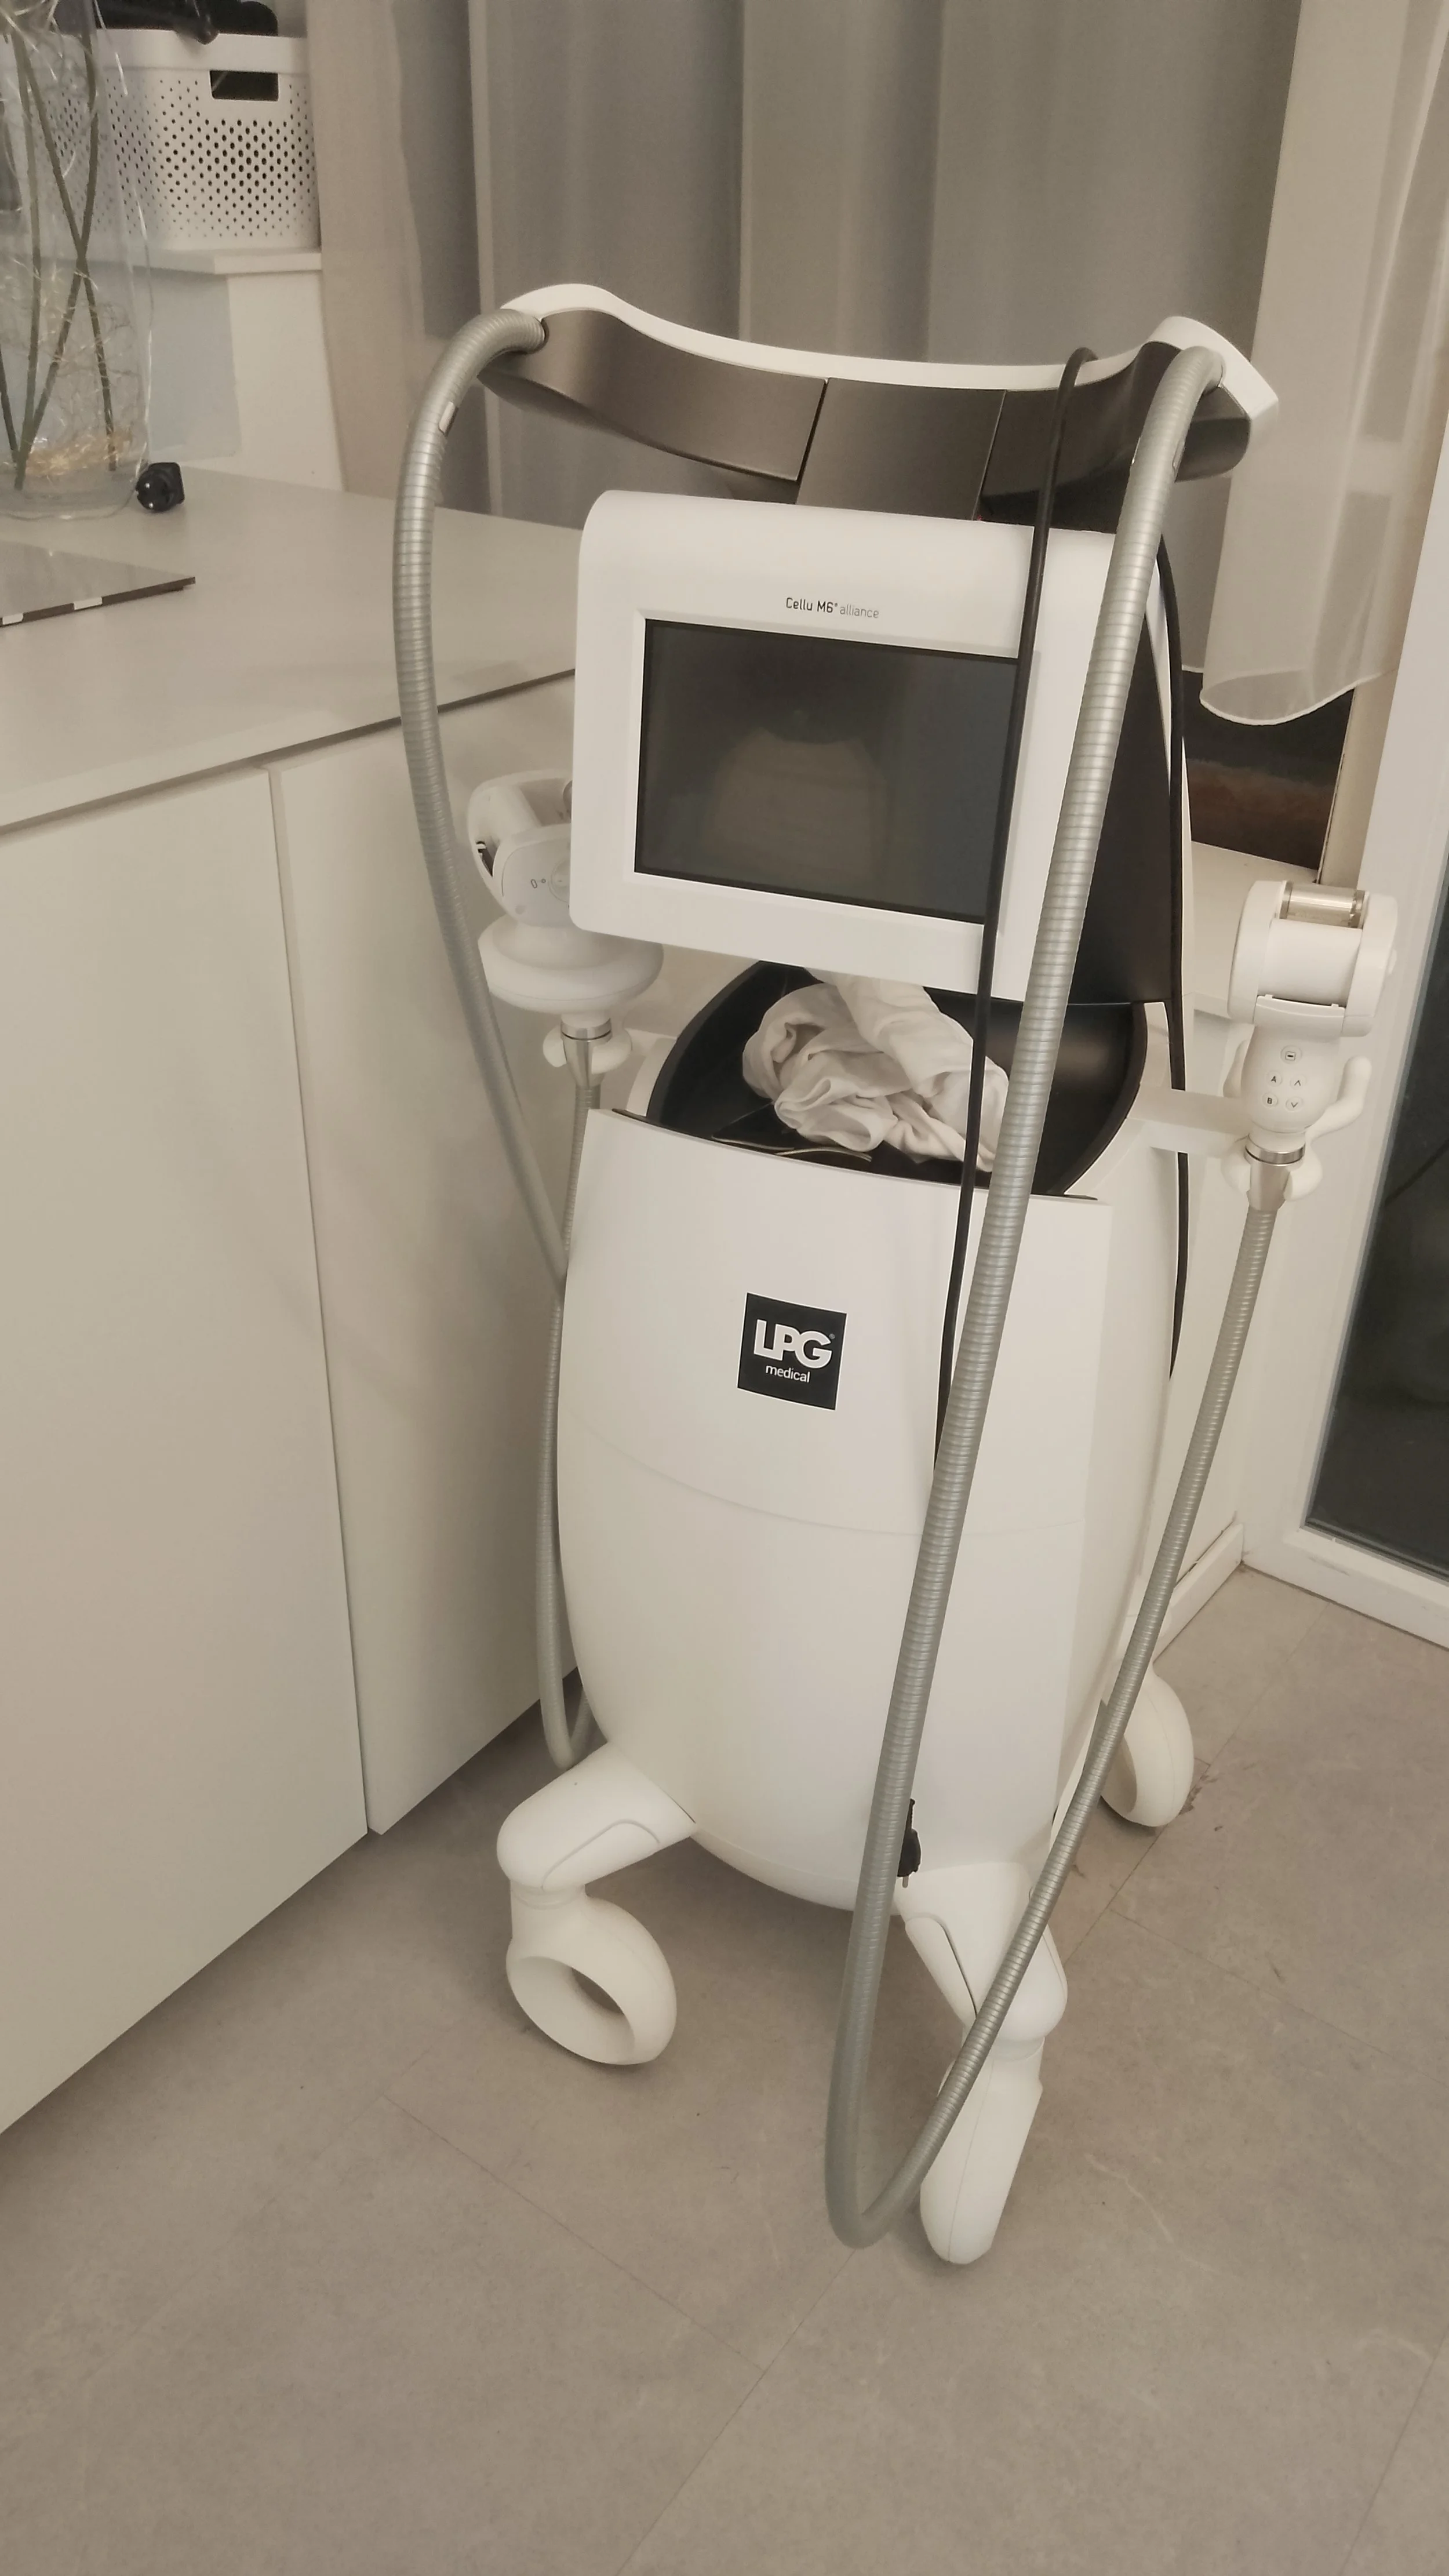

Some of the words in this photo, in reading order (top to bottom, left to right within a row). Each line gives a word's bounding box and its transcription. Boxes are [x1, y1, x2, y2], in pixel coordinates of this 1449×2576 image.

[786, 597, 813, 611] Cellu
[839, 604, 879, 618] alliance
[1270, 1075, 1277, 1083] A
[754, 1319, 832, 1369] LPG
[765, 1365, 811, 1383] medical
